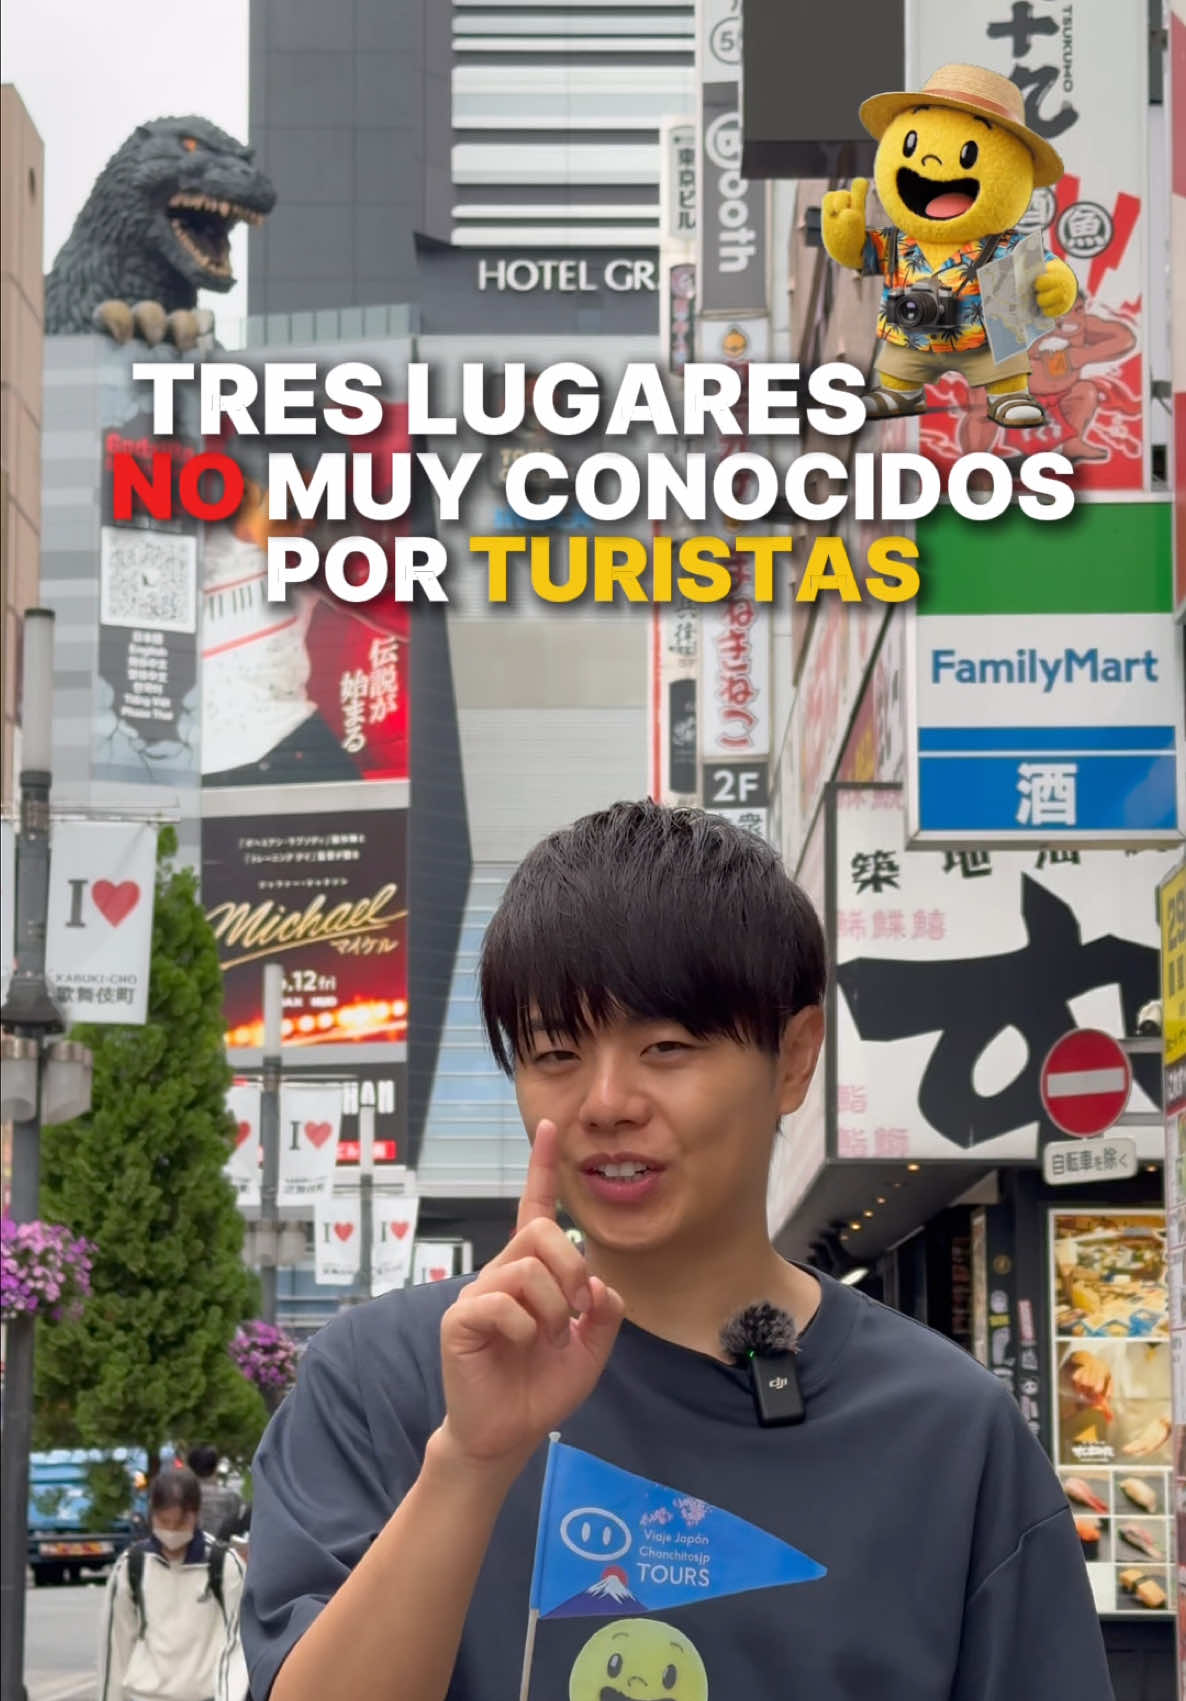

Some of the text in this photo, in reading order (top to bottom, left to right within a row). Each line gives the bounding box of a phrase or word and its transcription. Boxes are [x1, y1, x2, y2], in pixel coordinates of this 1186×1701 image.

[478, 259, 659, 291] HOTEL GR
[931, 648, 1159, 694] FamilyMart
[340, 667, 367, 753] 始まる
[713, 769, 760, 802] 2F
[1015, 761, 1078, 826] 酒
[65, 879, 88, 928] I
[204, 883, 408, 949] Michael
[329, 936, 398, 956] マイケル
[56, 973, 138, 985] KABUKI-CHO
[318, 975, 337, 990] fri
[55, 986, 135, 1005] 歌舞伎町
[289, 1121, 301, 1150] I
[643, 1528, 673, 1544] Viaje
[636, 1562, 711, 1588] TOURS
